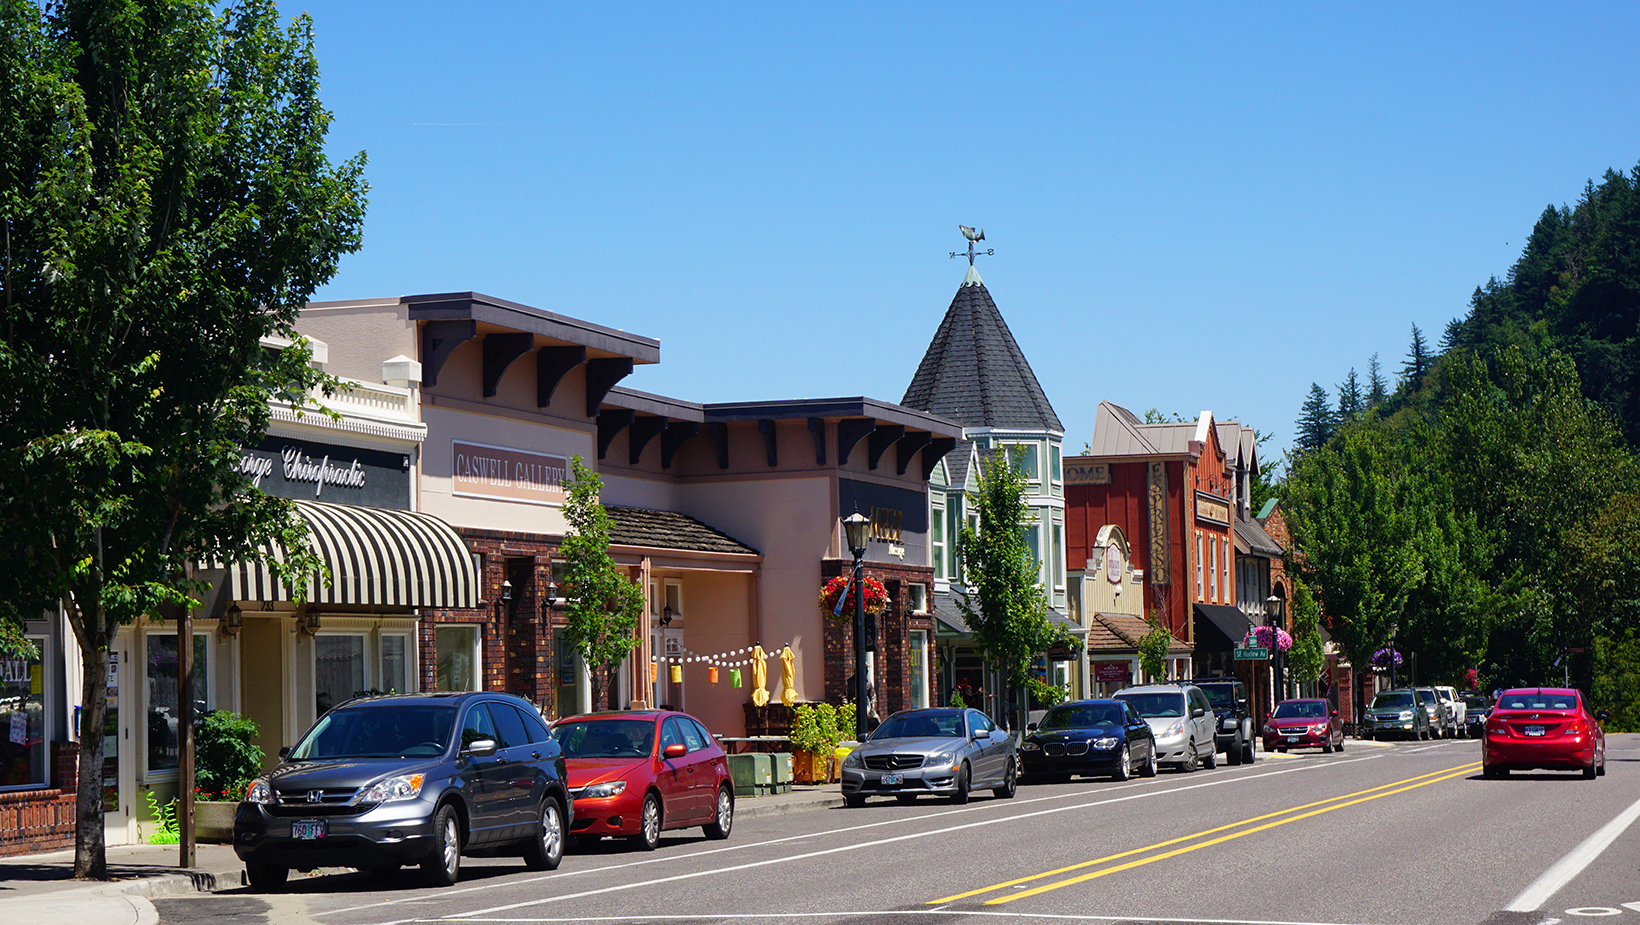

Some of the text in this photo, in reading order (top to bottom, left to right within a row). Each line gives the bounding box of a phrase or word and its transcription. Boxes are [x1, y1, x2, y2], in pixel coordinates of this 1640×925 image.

[281, 445, 366, 497] Chiropractic
[456, 454, 565, 494] CASWELL GALLERY
[1151, 462, 1166, 583] ESPRESSO
